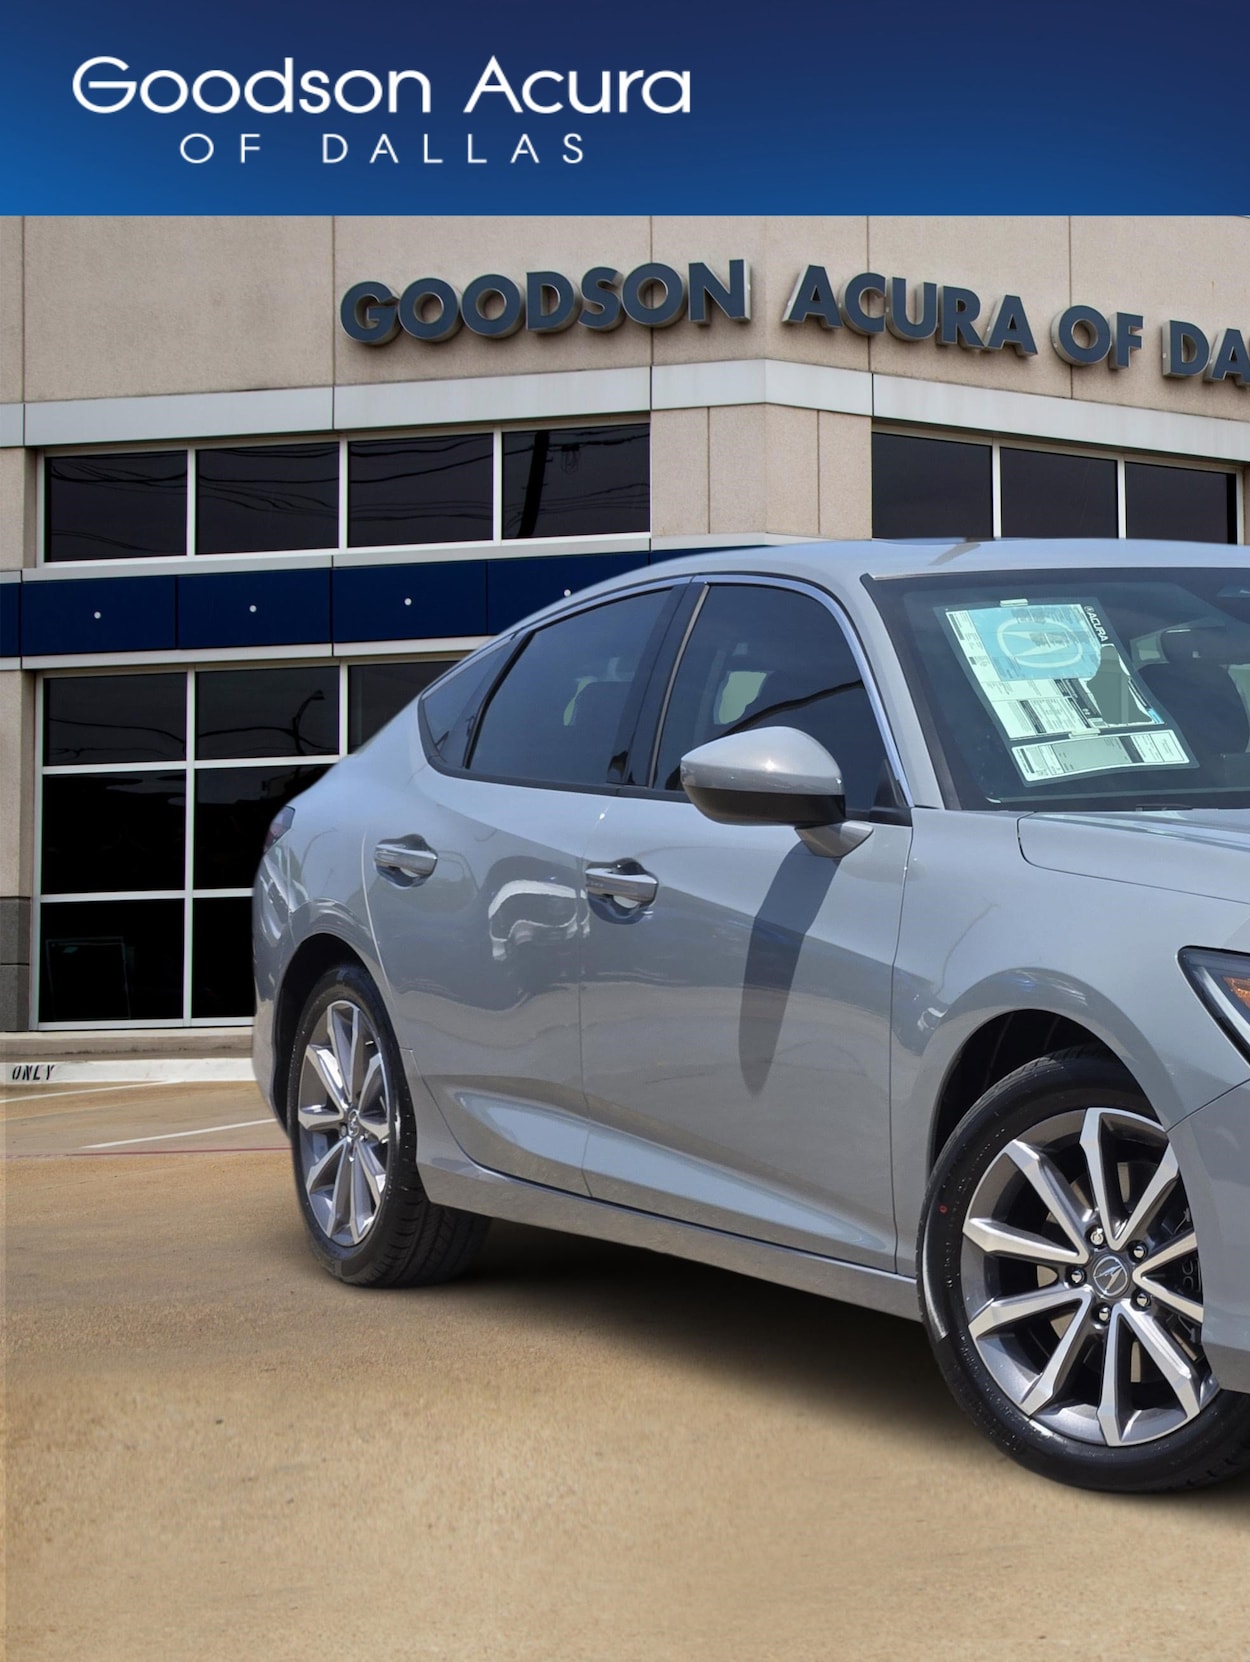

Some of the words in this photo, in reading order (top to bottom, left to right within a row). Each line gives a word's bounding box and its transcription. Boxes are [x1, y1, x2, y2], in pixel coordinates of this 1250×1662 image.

[340, 258, 751, 346] GOODSON
[783, 264, 1038, 358] ACURA
[1051, 304, 1144, 370] OF
[1087, 612, 1109, 642] ACURA
[12, 1064, 55, 1080] ONLY
